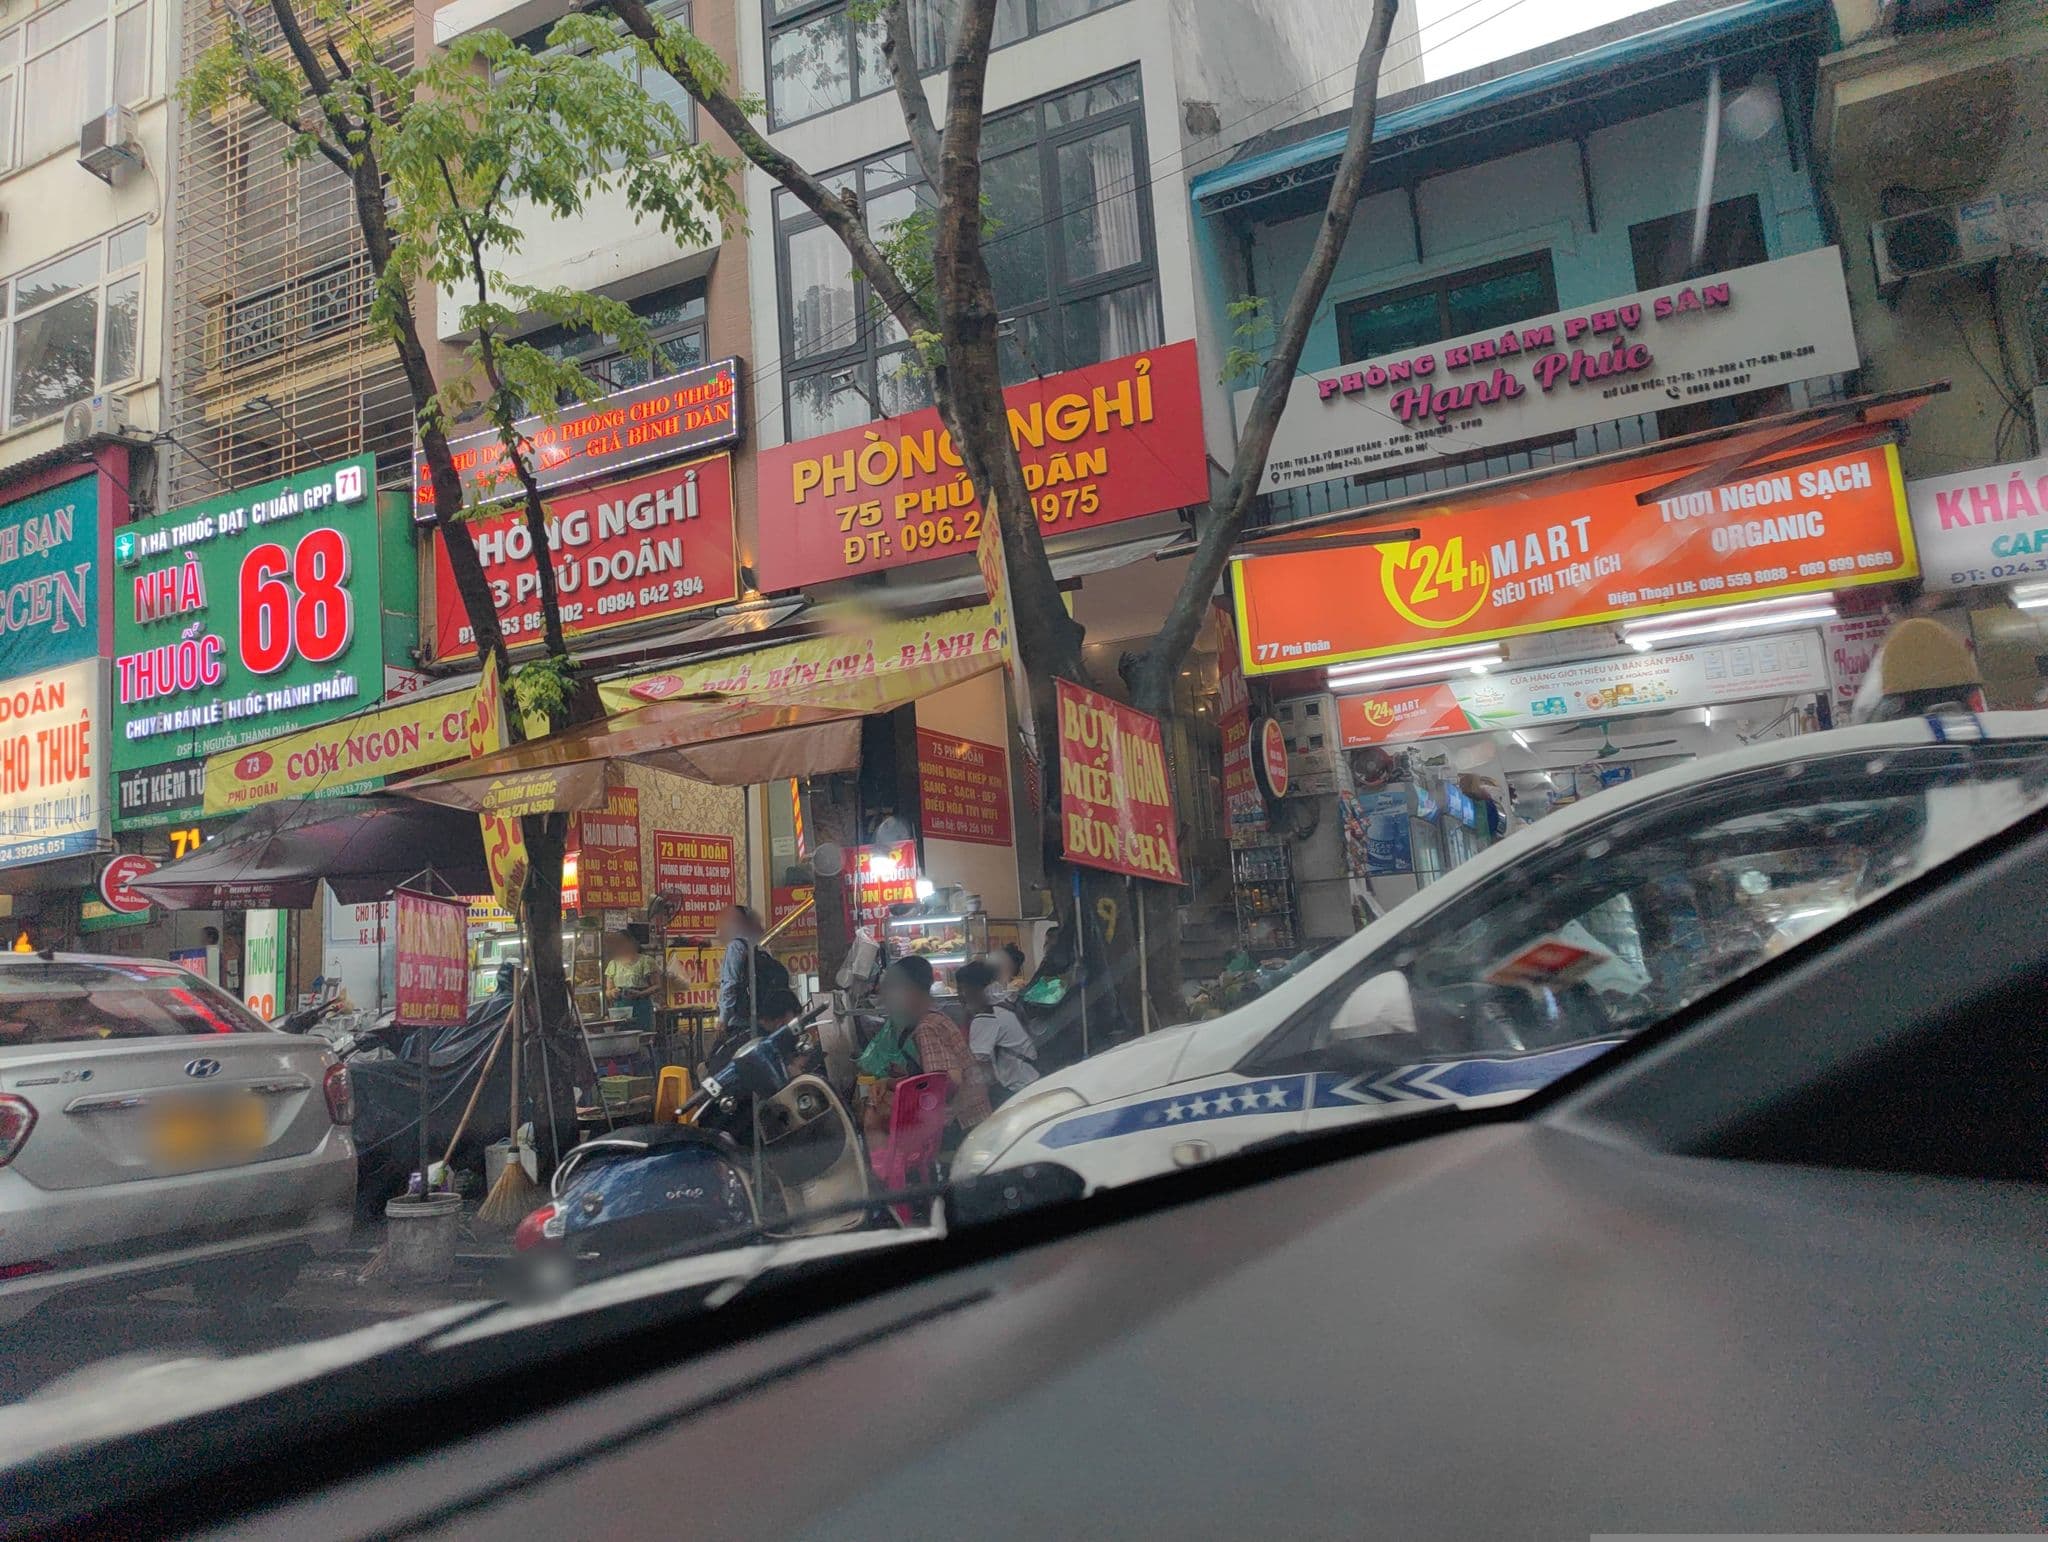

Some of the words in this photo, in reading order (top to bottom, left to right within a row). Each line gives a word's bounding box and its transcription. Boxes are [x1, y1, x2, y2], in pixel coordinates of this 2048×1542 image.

[1317, 353, 1436, 400] PHÒNG
[1444, 325, 1556, 371] KHÁM
[1563, 303, 1642, 341] PHỤ
[1654, 281, 1731, 320] SẢN
[1004, 357, 1154, 451] NGHỈ
[1390, 368, 1527, 424] Hạnh
[1532, 335, 1656, 390] Phúc
[451, 447, 476, 472] HỦ
[559, 404, 626, 442] PHÒNG
[628, 394, 671, 422] CHO
[586, 430, 621, 459] GIÁ
[626, 413, 681, 445] BÌNH
[684, 398, 731, 430] DÂN
[339, 470, 359, 496] 71
[834, 500, 885, 532] 75
[894, 470, 975, 520] PHỦ
[1719, 475, 1794, 513] NGON
[1797, 461, 1873, 501] SẠCH
[0, 524, 20, 564] H
[23, 505, 75, 558] SẠN
[140, 526, 168, 558] NHÀ
[171, 512, 214, 546] THUỐC
[303, 483, 333, 509] GPP
[473, 509, 590, 567] HÒG
[597, 468, 700, 540] NGHỈ
[1710, 510, 1826, 553] ORGANIC
[587, 536, 684, 587] DOÃN
[843, 530, 893, 565] ĐT:
[1490, 515, 1593, 580] MART
[1951, 568, 1985, 584] ĐT:
[1990, 558, 2048, 578] 024.3
[134, 551, 202, 623] NHÀ
[239, 527, 350, 675] 68
[597, 592, 635, 616] 0984
[640, 583, 669, 607] 642
[672, 574, 704, 599] 394
[1491, 582, 1526, 608] SIÊU
[1528, 574, 1555, 598] THỊ
[1554, 566, 1593, 592] TIỆN
[1593, 553, 1622, 578] ÍCH
[1608, 591, 1638, 607] Điện
[1639, 585, 1674, 603] Thoại
[1676, 579, 1698, 595] LH:
[1699, 575, 1724, 592] 086
[1726, 571, 1753, 588] 559
[116, 621, 221, 705] THUỐC
[643, 680, 666, 694] 75
[900, 631, 976, 669] BÁNH
[1257, 642, 1279, 661] 77
[1282, 641, 1303, 656] Phủ
[1529, 671, 1557, 685] HÀNG
[1557, 668, 1578, 681] GIỚI
[1579, 664, 1607, 676] THIỆU
[1607, 661, 1621, 674] VÀ
[1621, 659, 1643, 672] BÁN
[1643, 656, 1664, 669] SẢN
[1664, 652, 1696, 666] PHẨM
[125, 714, 173, 739] CHUYÊN
[174, 701, 202, 731] BÁN
[203, 698, 223, 724] LẺ
[221, 690, 263, 720] THUỐC
[265, 683, 312, 712] THÀNH
[312, 670, 355, 703] PHẨM
[1063, 693, 1118, 754] BÚN
[1393, 698, 1420, 714] MART
[0, 734, 31, 795] HO
[37, 708, 91, 788] THUÊ
[245, 757, 261, 773] 73
[286, 739, 341, 781] CƠM
[346, 722, 421, 768] NGON
[932, 741, 943, 756] 75
[1062, 753, 1124, 810] MIẾN
[1120, 730, 1170, 807] NGAN
[121, 766, 149, 809] TIẾT
[151, 764, 186, 807] KIỆM
[497, 785, 526, 803] MINH
[525, 780, 558, 799] NGỌC
[922, 780, 948, 795] SANG
[170, 828, 201, 859] 71
[661, 842, 673, 857] 73
[677, 838, 698, 859] PHỦ
[701, 842, 729, 861] DOÃN
[1067, 802, 1121, 863] BÚN
[1122, 823, 1177, 876] CHẢ
[585, 859, 600, 872] RAU
[883, 880, 915, 902] CHẢ
[355, 904, 369, 922] CHO
[685, 899, 707, 912] BÌNH
[1096, 896, 1118, 945] 9
[247, 922, 275, 978] THUỐC
[359, 928, 368, 945] XE
[401, 1002, 420, 1018] RAU
